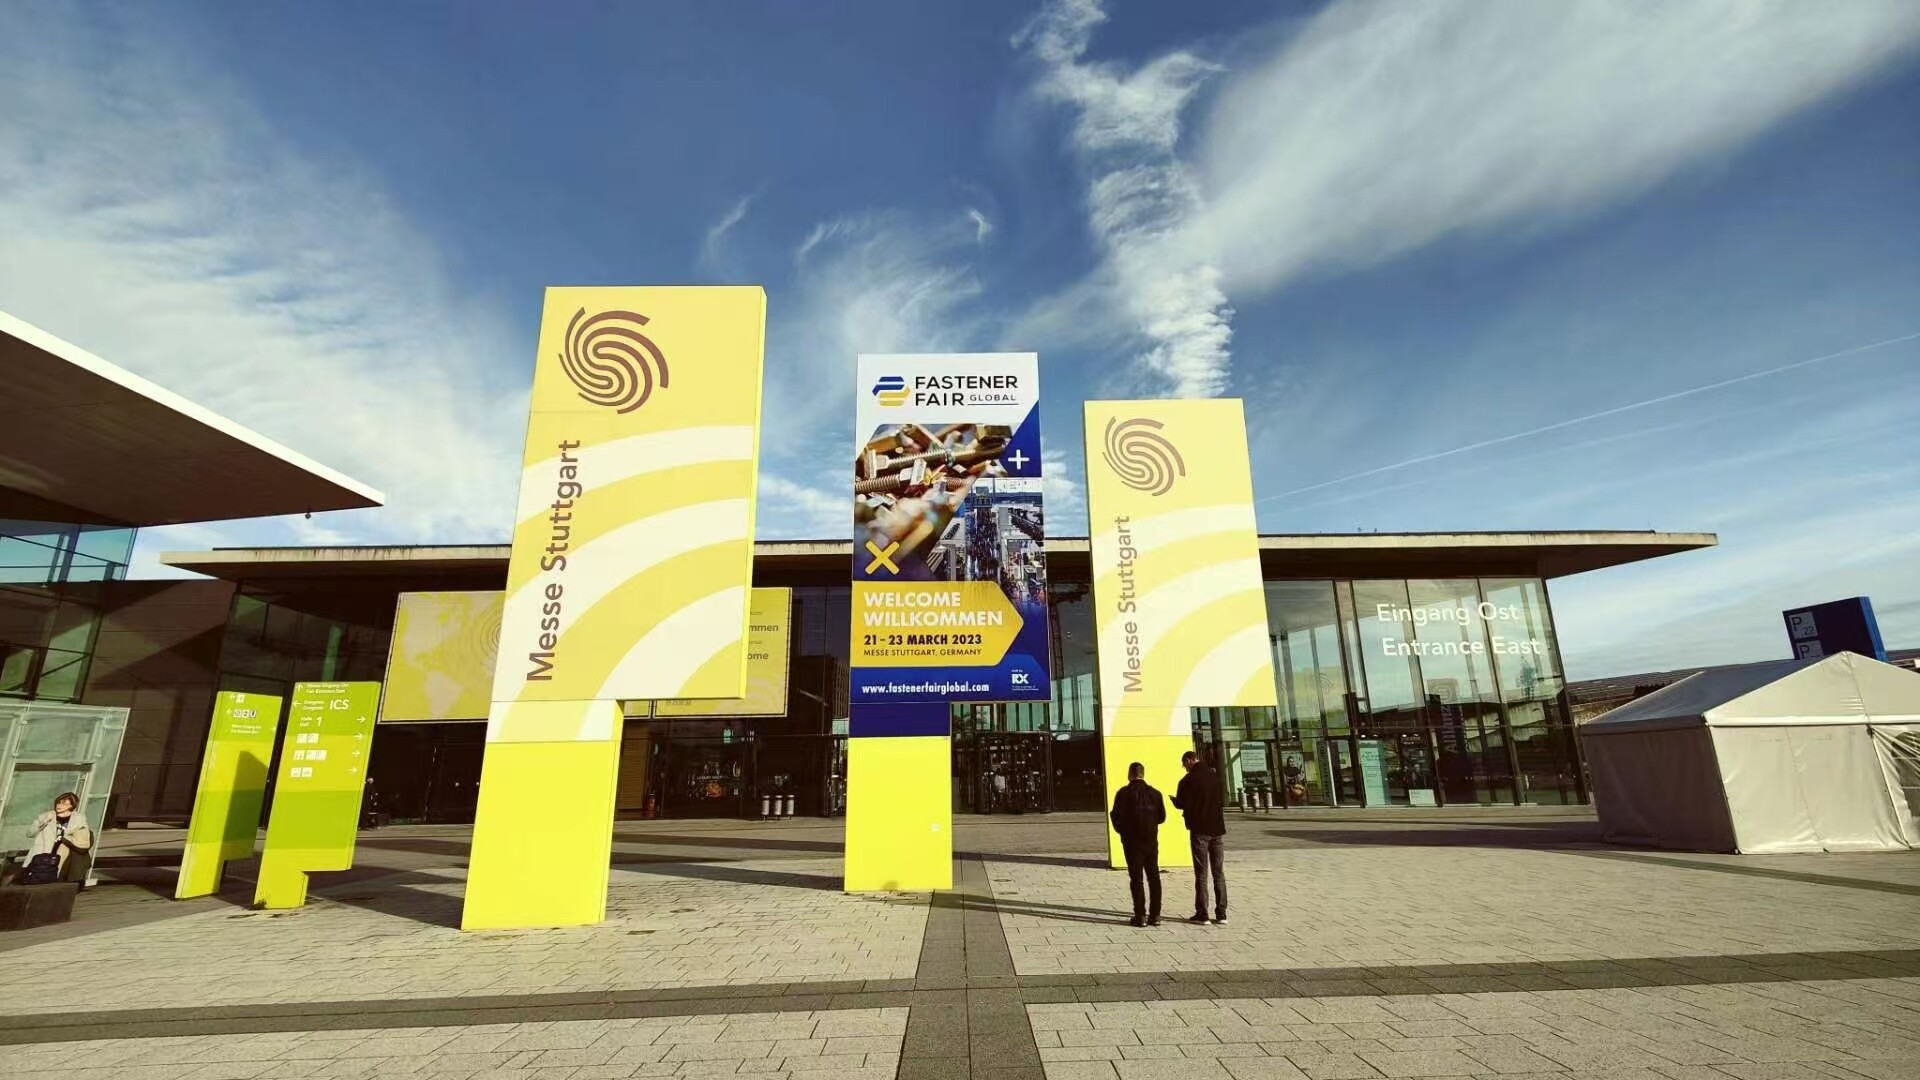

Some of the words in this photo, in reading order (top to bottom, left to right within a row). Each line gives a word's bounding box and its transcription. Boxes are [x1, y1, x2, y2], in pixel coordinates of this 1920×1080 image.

[915, 375, 1018, 389] FASTENER
[915, 393, 965, 406] FAIR
[969, 394, 1017, 402] GLOBAL
[540, 440, 582, 572] Stuttgart
[1114, 515, 1137, 613] Stuttgart
[863, 591, 961, 607] WELCOME
[863, 610, 1003, 627] WILLKOMMEN
[1376, 603, 1470, 626] Eingang
[1478, 602, 1520, 620] Ost
[526, 583, 563, 681] Messe
[863, 635, 877, 646] 21
[888, 634, 903, 645] 23
[907, 634, 948, 645] MARCH
[952, 634, 982, 645] 2023
[863, 649, 890, 657] MESSE
[891, 649, 938, 657] STUTTGART,
[940, 648, 982, 656] GERMANY
[1382, 637, 1484, 656] Entrance
[1491, 636, 1541, 655] East
[1123, 622, 1142, 693] Messe
[1011, 673, 1029, 685] RX
[861, 681, 990, 695] www.fastenerfairglobal.com
[329, 698, 350, 710] ICS
